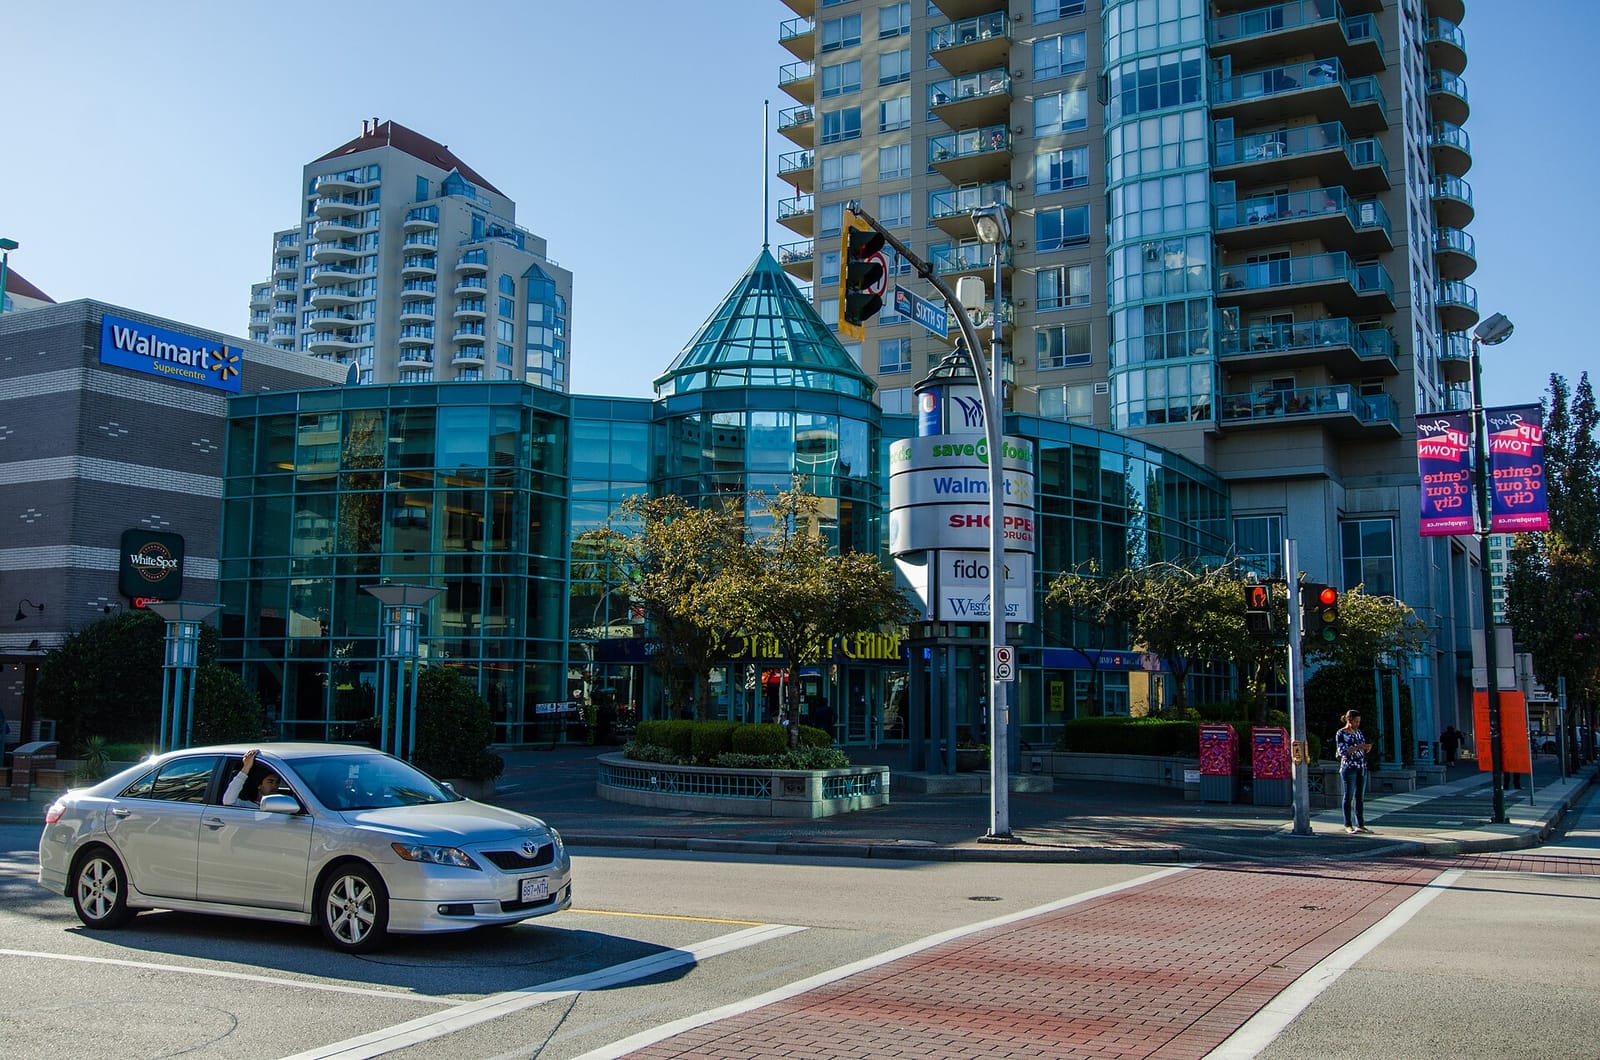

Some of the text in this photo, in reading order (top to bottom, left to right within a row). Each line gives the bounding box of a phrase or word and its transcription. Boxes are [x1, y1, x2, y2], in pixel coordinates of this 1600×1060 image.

[916, 302, 945, 331] SIXTH ST
[112, 325, 209, 369] Walmart
[153, 361, 206, 381] Supercentre
[932, 443, 974, 458] save
[1003, 442, 1033, 462] food
[933, 477, 1012, 495] Walmt
[953, 560, 989, 579] fido
[948, 598, 987, 616] WEST
